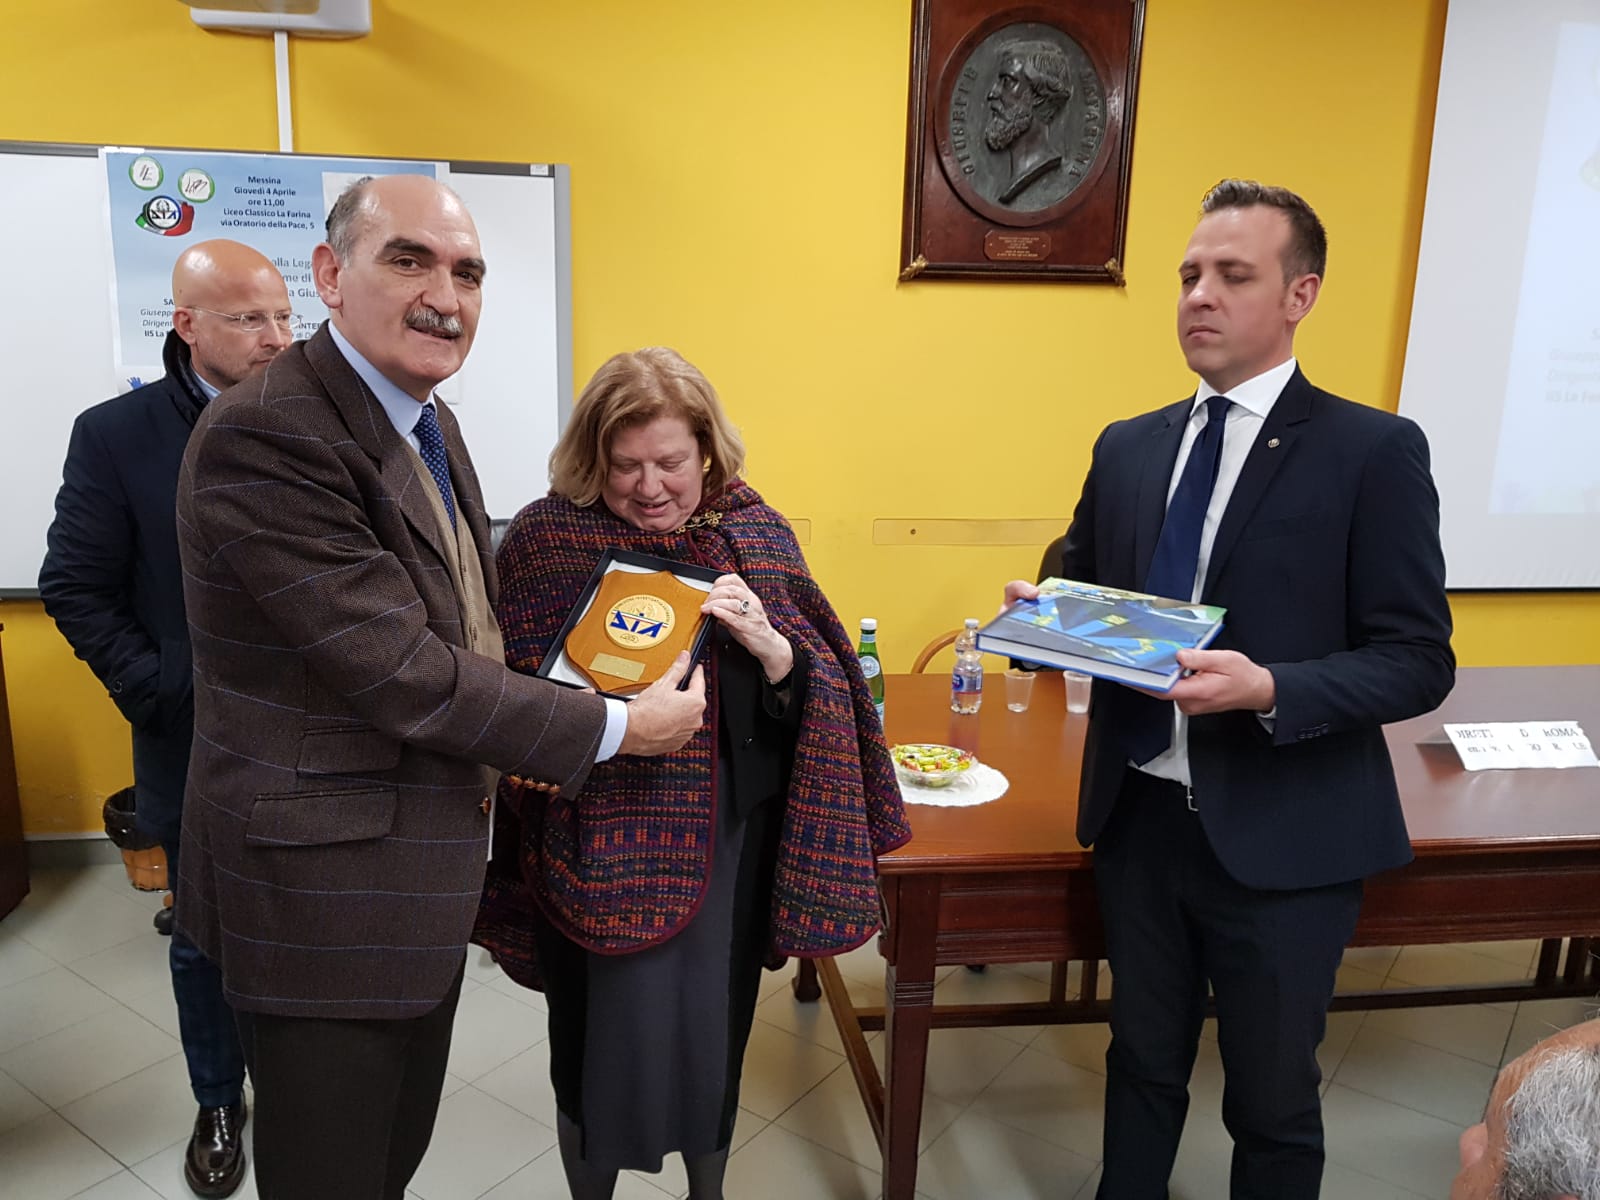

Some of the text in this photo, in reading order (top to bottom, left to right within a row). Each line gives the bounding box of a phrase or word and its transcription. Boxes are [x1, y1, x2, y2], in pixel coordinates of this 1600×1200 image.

[248, 176, 281, 185] Messina
[272, 188, 296, 196] Aprile
[263, 199, 285, 207] 11,00
[223, 208, 311, 219] Liceo Classico La Farina
[233, 219, 267, 228] Oratorio
[267, 220, 287, 228] della
[288, 221, 308, 230] Pace,
[292, 257, 312, 269] Leg
[301, 273, 311, 282] di
[298, 288, 320, 298] Gius
[163, 298, 174, 306] SA
[140, 308, 174, 318] Giusepp
[142, 319, 173, 328] Dirigent
[155, 329, 165, 337] La
